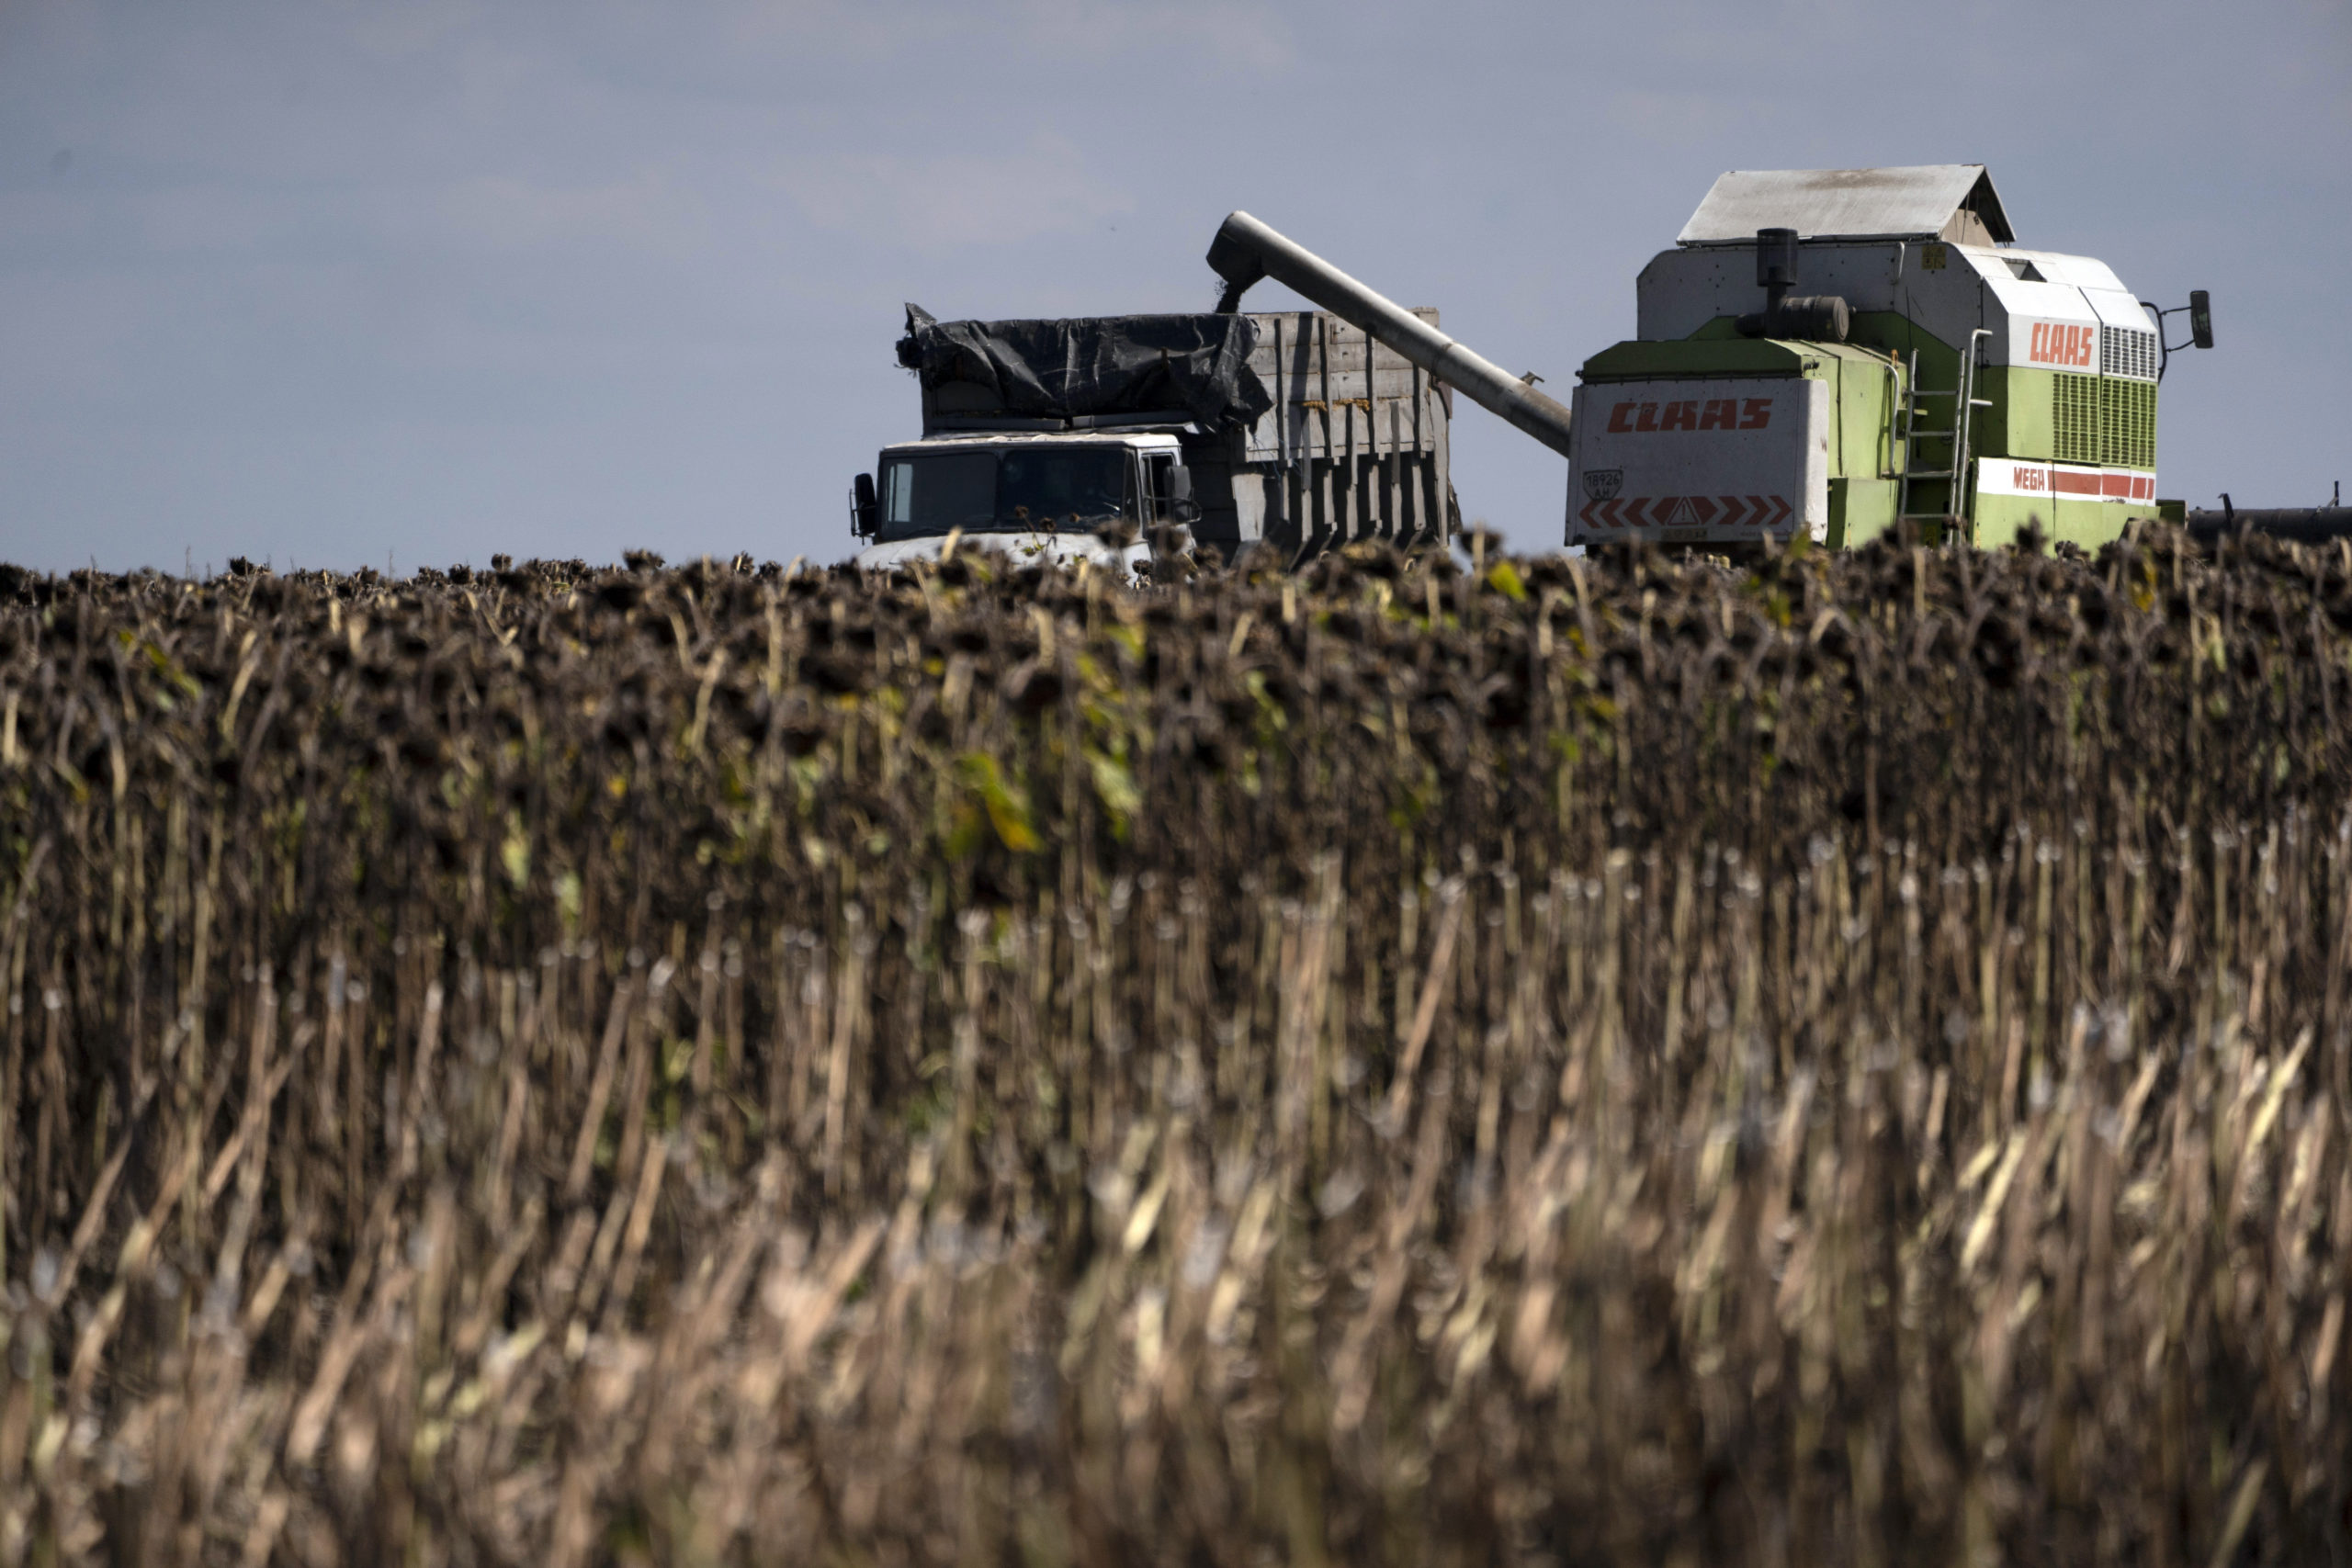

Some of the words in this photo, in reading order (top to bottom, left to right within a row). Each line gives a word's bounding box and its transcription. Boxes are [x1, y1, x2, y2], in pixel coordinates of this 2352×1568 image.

[2030, 322, 2093, 367] CLAAS
[1607, 399, 1773, 433] CLAAS
[1587, 473, 1620, 486] 18926
[2013, 467, 2045, 491] MEGA
